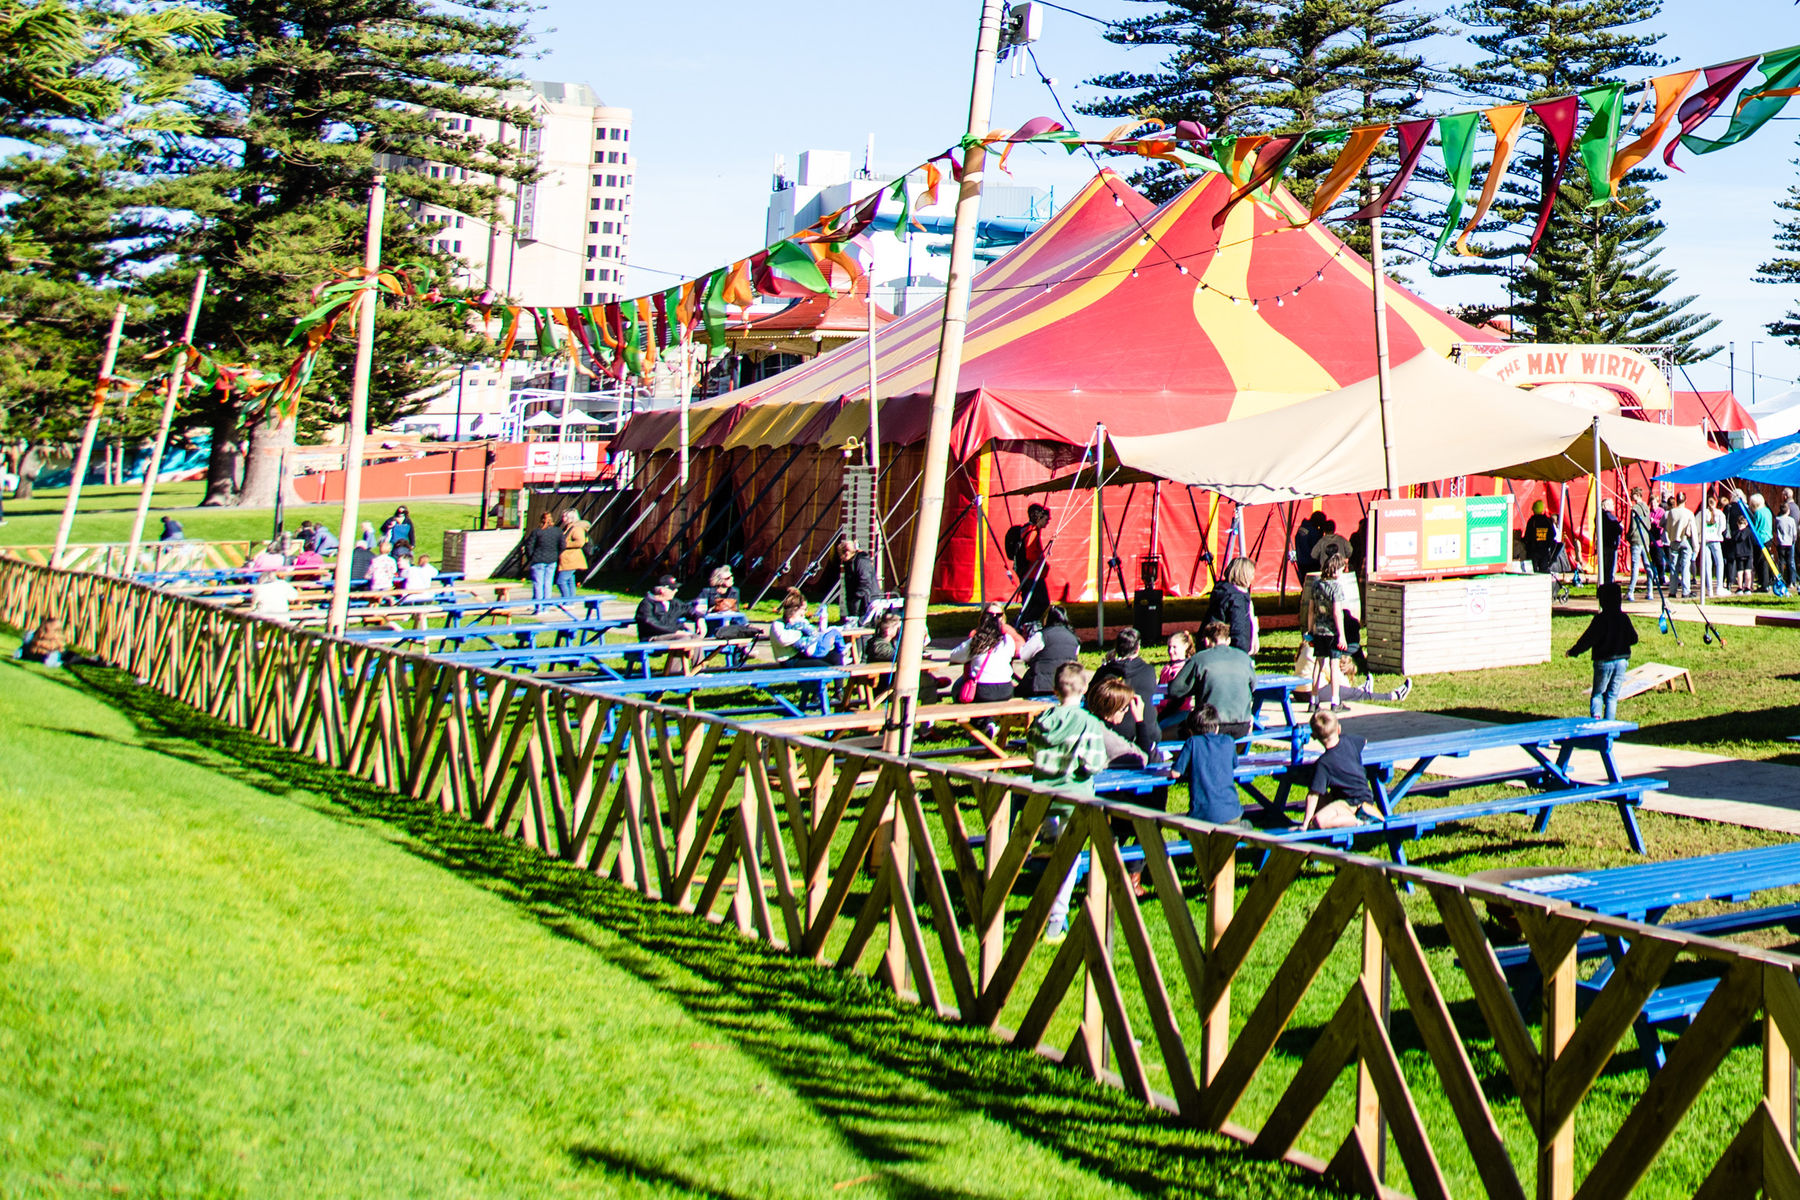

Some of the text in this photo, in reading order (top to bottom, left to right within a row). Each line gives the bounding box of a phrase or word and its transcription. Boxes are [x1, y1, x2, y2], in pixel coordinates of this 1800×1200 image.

[1497, 352, 1646, 385] THE MAY WIRTH
